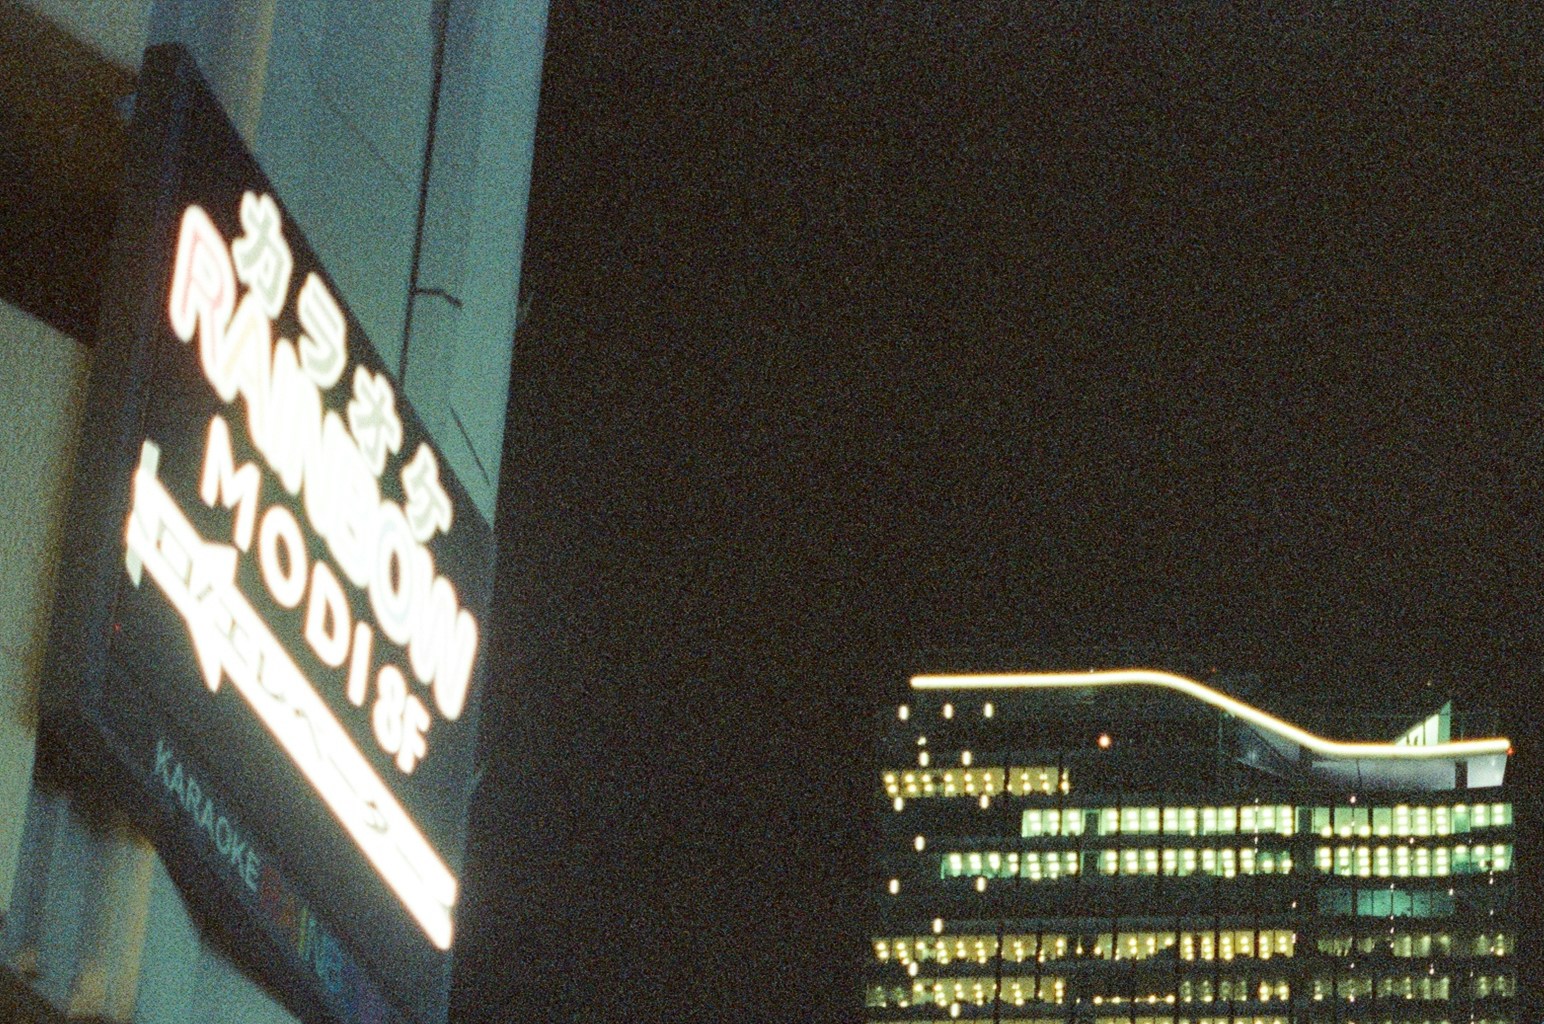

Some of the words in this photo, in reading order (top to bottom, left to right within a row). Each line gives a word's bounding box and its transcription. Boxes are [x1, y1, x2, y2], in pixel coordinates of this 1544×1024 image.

[169, 205, 479, 721] RAINBOW
[232, 190, 453, 543] カラオケ
[200, 414, 373, 706] MODI
[373, 663, 431, 774] 8F
[154, 740, 260, 892] KARAOKE
